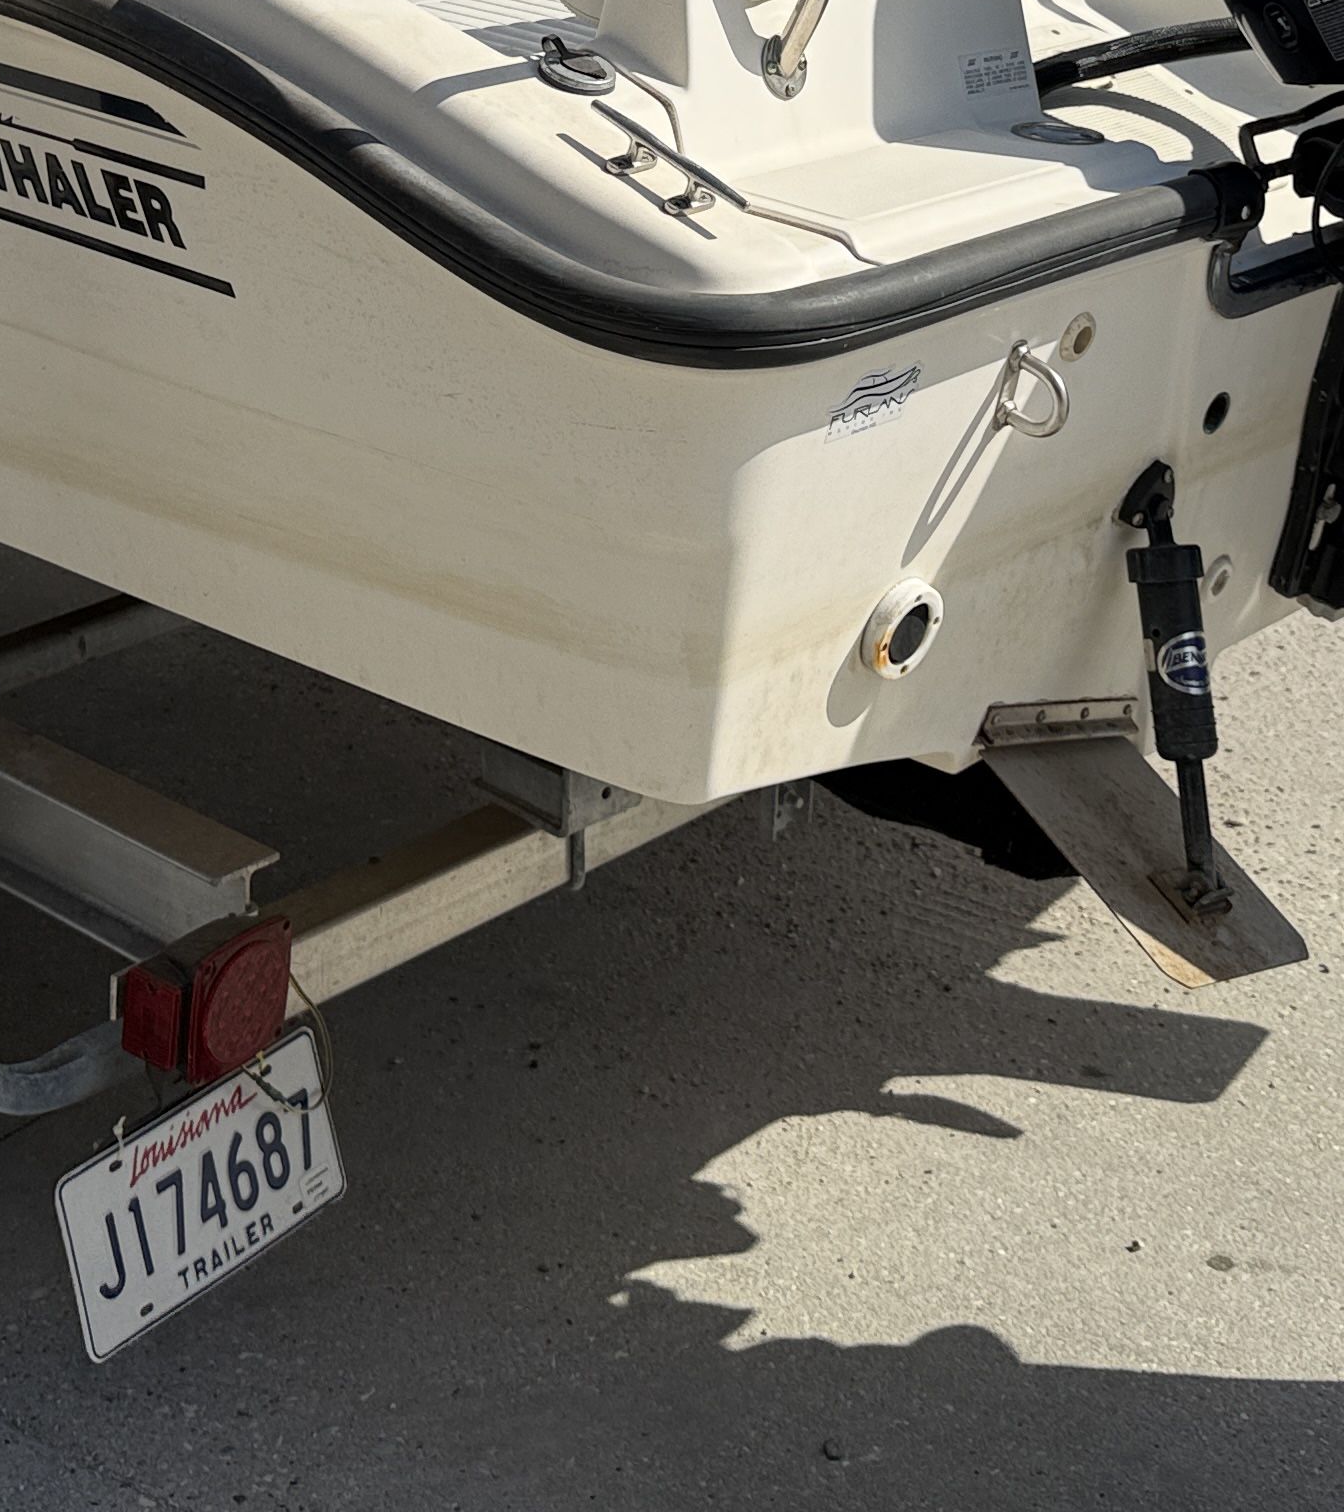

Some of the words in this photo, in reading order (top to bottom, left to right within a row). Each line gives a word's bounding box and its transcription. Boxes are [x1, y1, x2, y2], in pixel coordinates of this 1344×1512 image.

[129, 1083, 257, 1188] Louisiana
[99, 1087, 314, 1300] J174687
[177, 1212, 276, 1290] TRAILER
